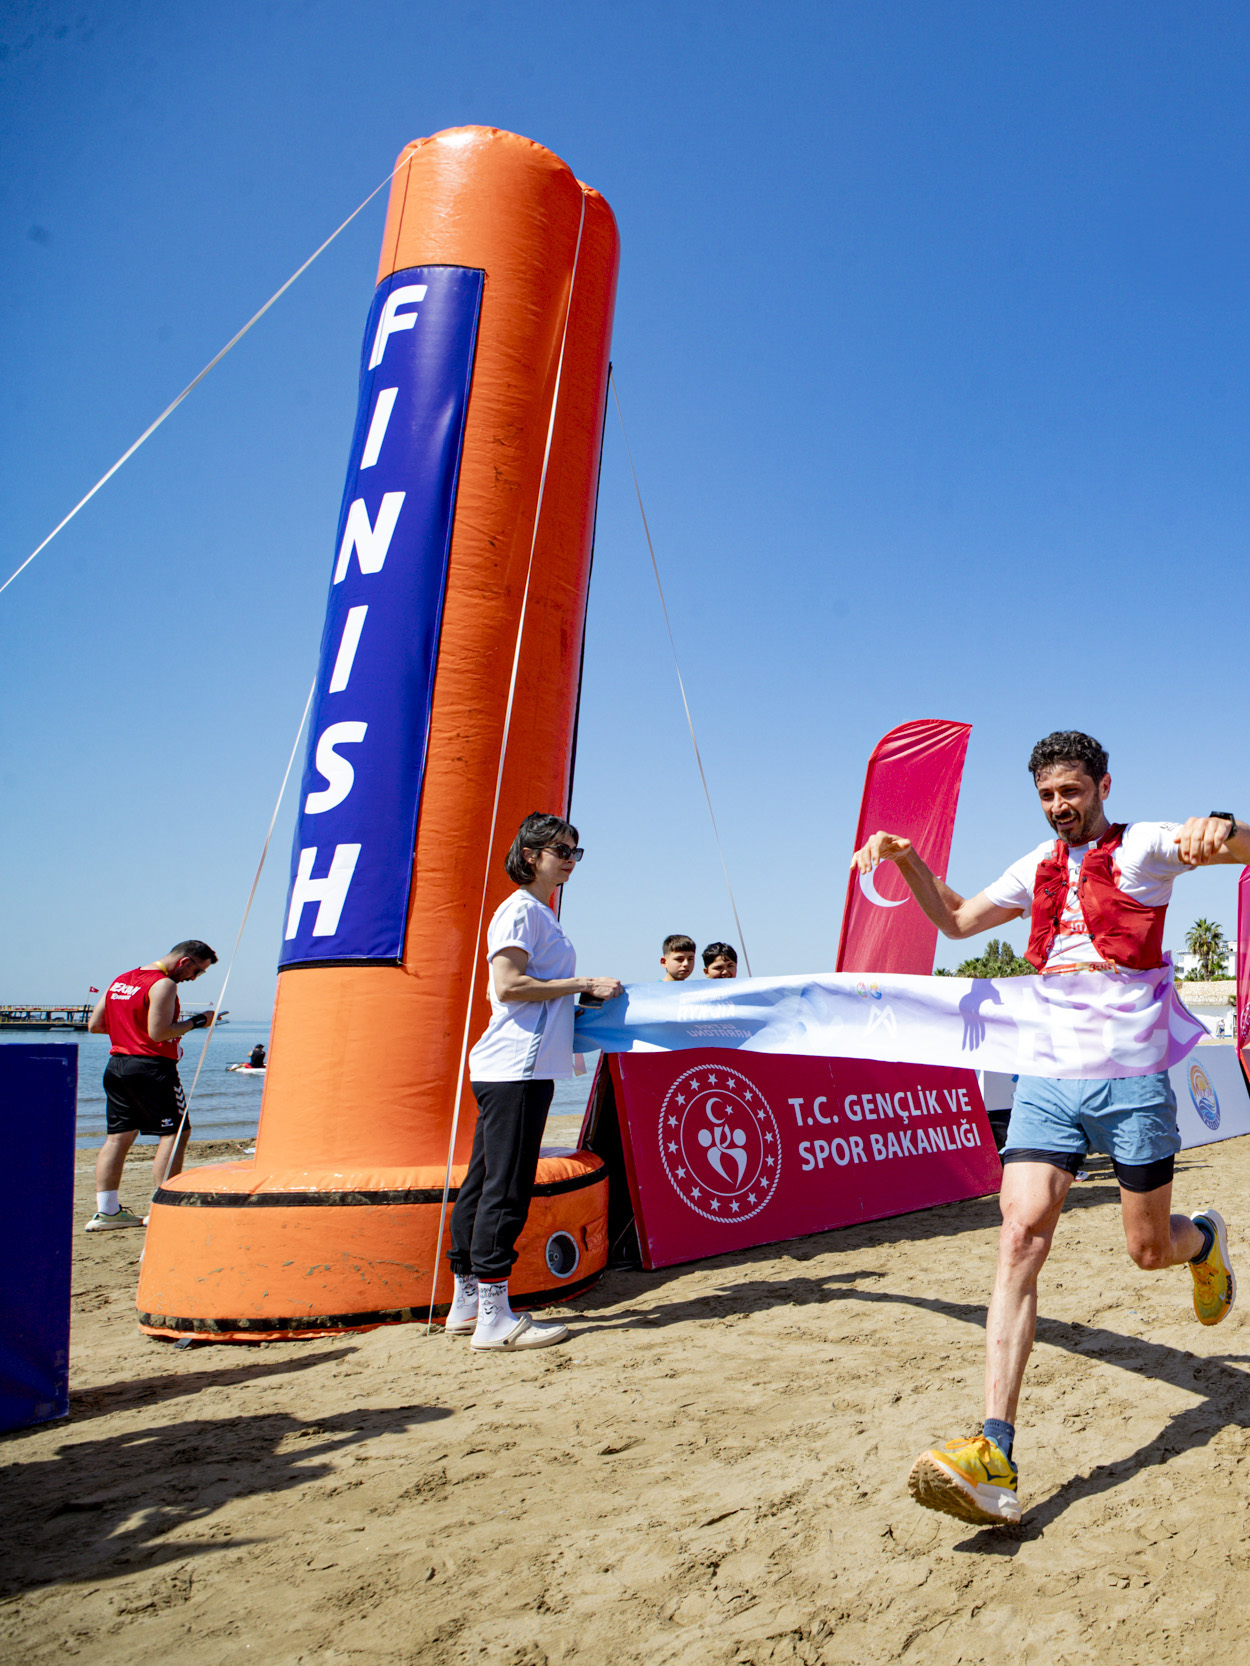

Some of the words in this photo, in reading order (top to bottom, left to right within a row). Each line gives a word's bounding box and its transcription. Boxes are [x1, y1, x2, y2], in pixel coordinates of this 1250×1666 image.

[286, 285, 428, 941] FINISH
[788, 1096, 839, 1127] T.C.
[844, 1085, 942, 1125] GENÇLİK
[943, 1088, 972, 1113] VE
[798, 1135, 868, 1172] SPOR
[869, 1118, 981, 1161] BAKANLIĞI
